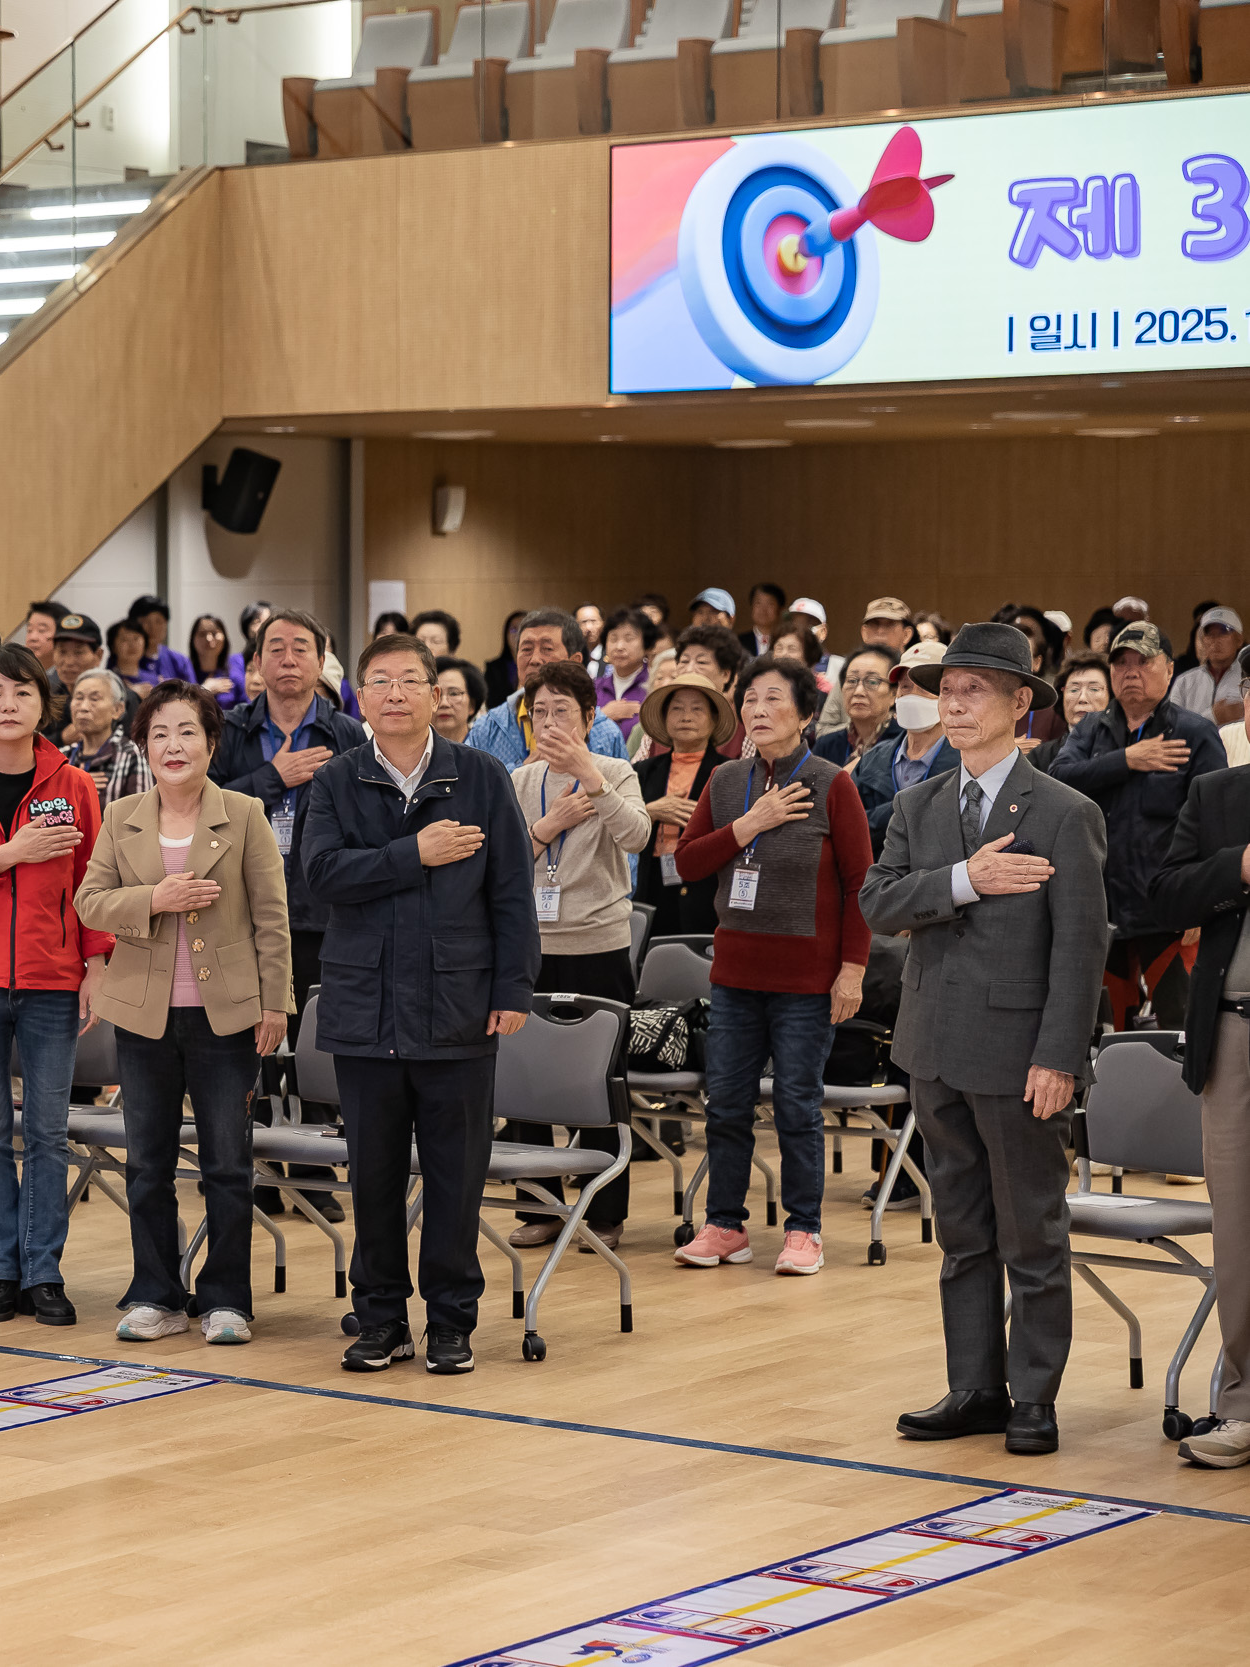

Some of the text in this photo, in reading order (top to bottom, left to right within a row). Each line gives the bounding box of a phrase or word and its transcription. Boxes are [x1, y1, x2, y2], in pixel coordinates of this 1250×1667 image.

[1008, 153, 1250, 270] 제 3
[29, 797, 68, 814] 시의원
